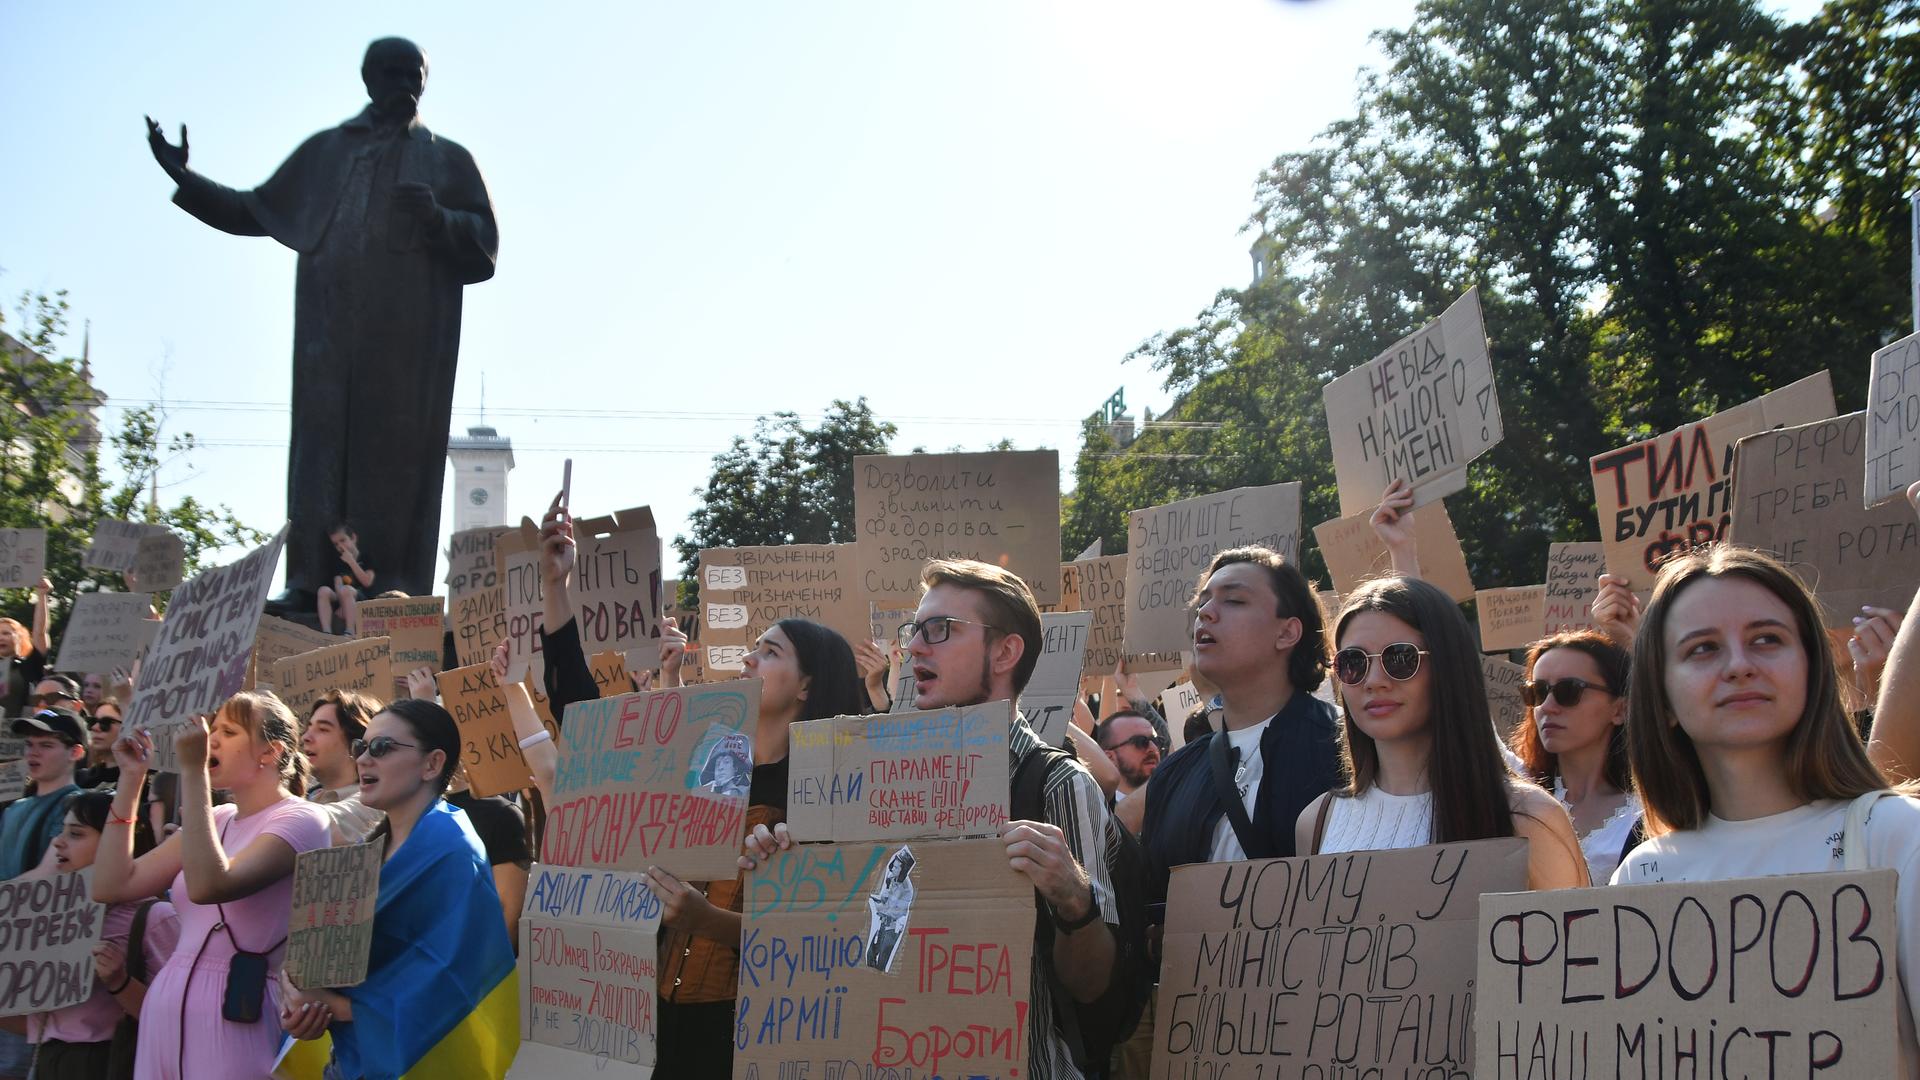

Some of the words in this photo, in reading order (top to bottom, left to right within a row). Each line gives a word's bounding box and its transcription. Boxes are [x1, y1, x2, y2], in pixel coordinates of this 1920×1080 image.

[1369, 357, 1399, 408] НЕ
[1399, 336, 1446, 389] ВІД
[1358, 358, 1465, 462] НАШОГО
[1773, 417, 1863, 476] РЕФО
[864, 462, 996, 497] Дозволити
[1593, 424, 1715, 508] ТИЛ
[878, 490, 1004, 518] звільнити
[1615, 492, 1699, 542] БУТИ
[1707, 478, 1732, 518] ГІ
[1751, 478, 1849, 524] ТРЕБА
[865, 515, 998, 539] Федорова
[1135, 494, 1245, 549] ЗАЛИШТЕ
[452, 531, 503, 559] МІНІ
[734, 551, 835, 566] ЗВІЛЬНЕННЯ
[880, 540, 983, 563] зрадити
[452, 572, 497, 594] ФРО
[708, 569, 742, 584] БЕЗ
[749, 569, 838, 586] ПРИЧИНИ
[865, 569, 918, 593] Сил
[1138, 578, 1194, 610] ОБОРО
[733, 588, 842, 603] ПРИЗНАЧЕННЯ
[1546, 605, 1574, 619] МИ
[459, 613, 507, 648] ФЕД
[708, 608, 743, 622] БЕЗ
[751, 605, 822, 622] ЛОГІКИ
[460, 668, 499, 697] ДЖЕ
[455, 697, 505, 723] ВЛАД
[614, 692, 682, 749] ЕГО
[793, 766, 863, 806] НЕХАЙ
[870, 754, 983, 784] ПАРЛАМЕНТ
[870, 789, 926, 808] СКАЖЕ
[543, 791, 647, 867] ОБОРОНУ
[639, 793, 746, 858] ДЕРЖАВИ
[869, 809, 927, 828] ВІДСТАВЦІ
[935, 803, 1008, 830] ФЕДОРОВА
[751, 845, 886, 922] ВОВА!
[1640, 861, 1658, 877] ТИ
[527, 870, 593, 917] АУДИТ
[593, 873, 661, 921] ПОКАЗАВ
[1219, 855, 1372, 930] ЧОМУ
[1416, 848, 1469, 921] У
[908, 927, 1012, 998] ТРЕБА
[1194, 914, 1418, 992] МІНІСТРІВ
[532, 986, 582, 1007] ПРИБРАЛИ
[586, 978, 651, 1034] АУДИТОРА
[532, 1007, 539, 1027] А
[545, 1012, 559, 1030] НЕ
[757, 985, 848, 1046] АРМІЇ
[1167, 984, 1300, 1056] БІЛЬШЕ
[1616, 1017, 1843, 1080] МІНІСТР
